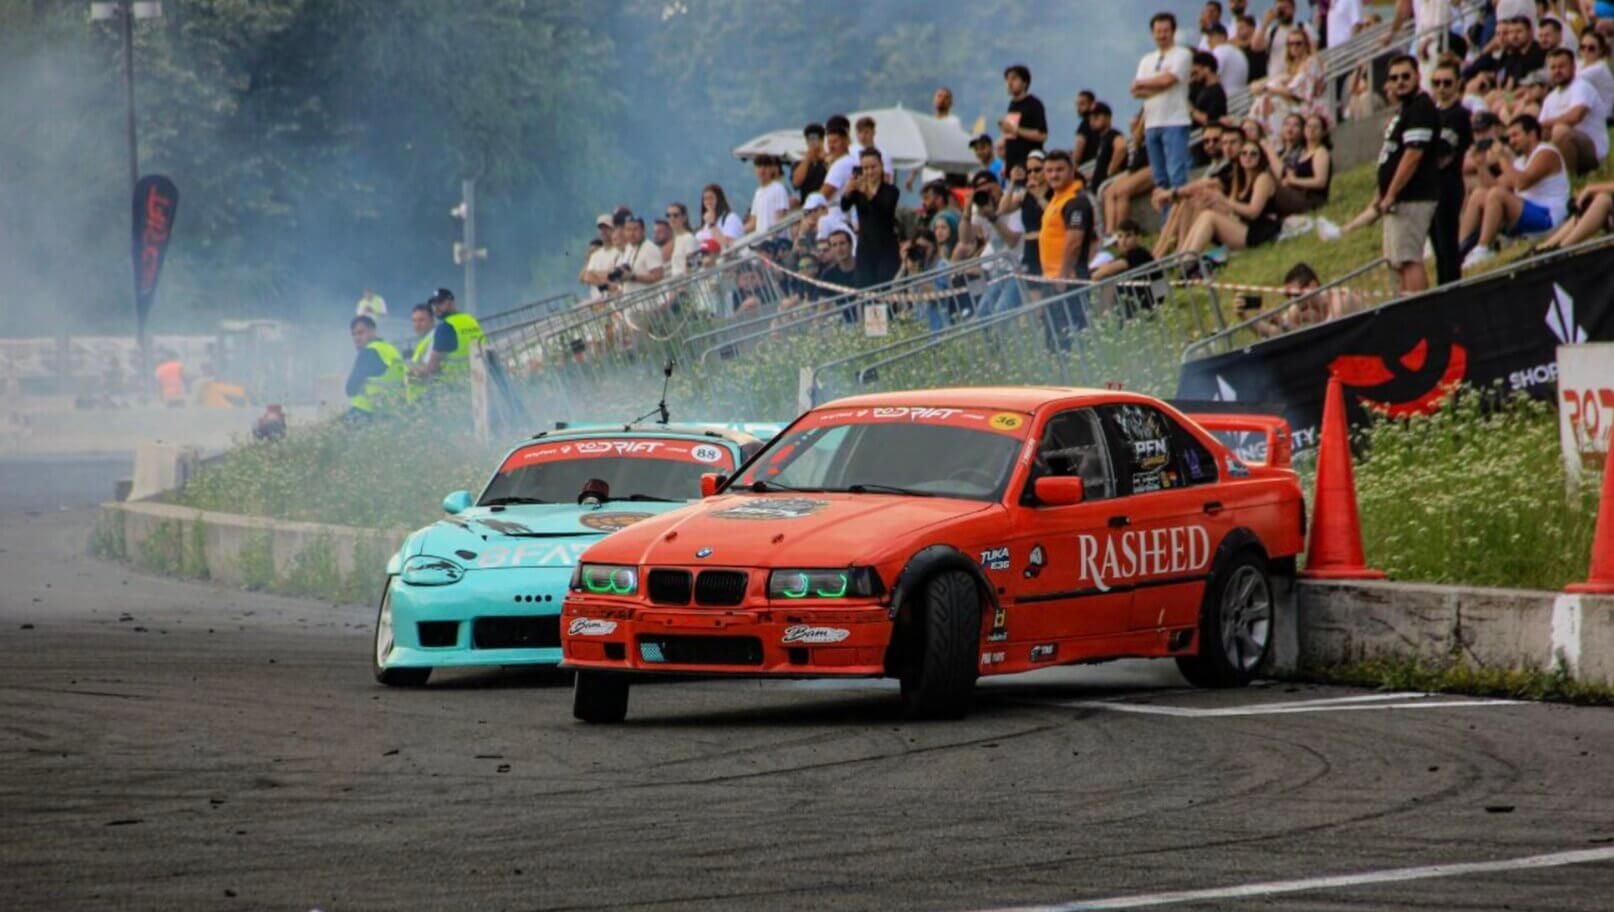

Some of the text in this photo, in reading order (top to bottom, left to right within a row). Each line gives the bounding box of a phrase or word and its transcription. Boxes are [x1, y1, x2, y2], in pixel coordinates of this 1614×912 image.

[995, 416, 1017, 427] 36
[696, 448, 717, 461] 88
[1135, 438, 1168, 458] PFN
[981, 546, 1010, 565] TUKA
[1078, 525, 1211, 593] RASHEED
